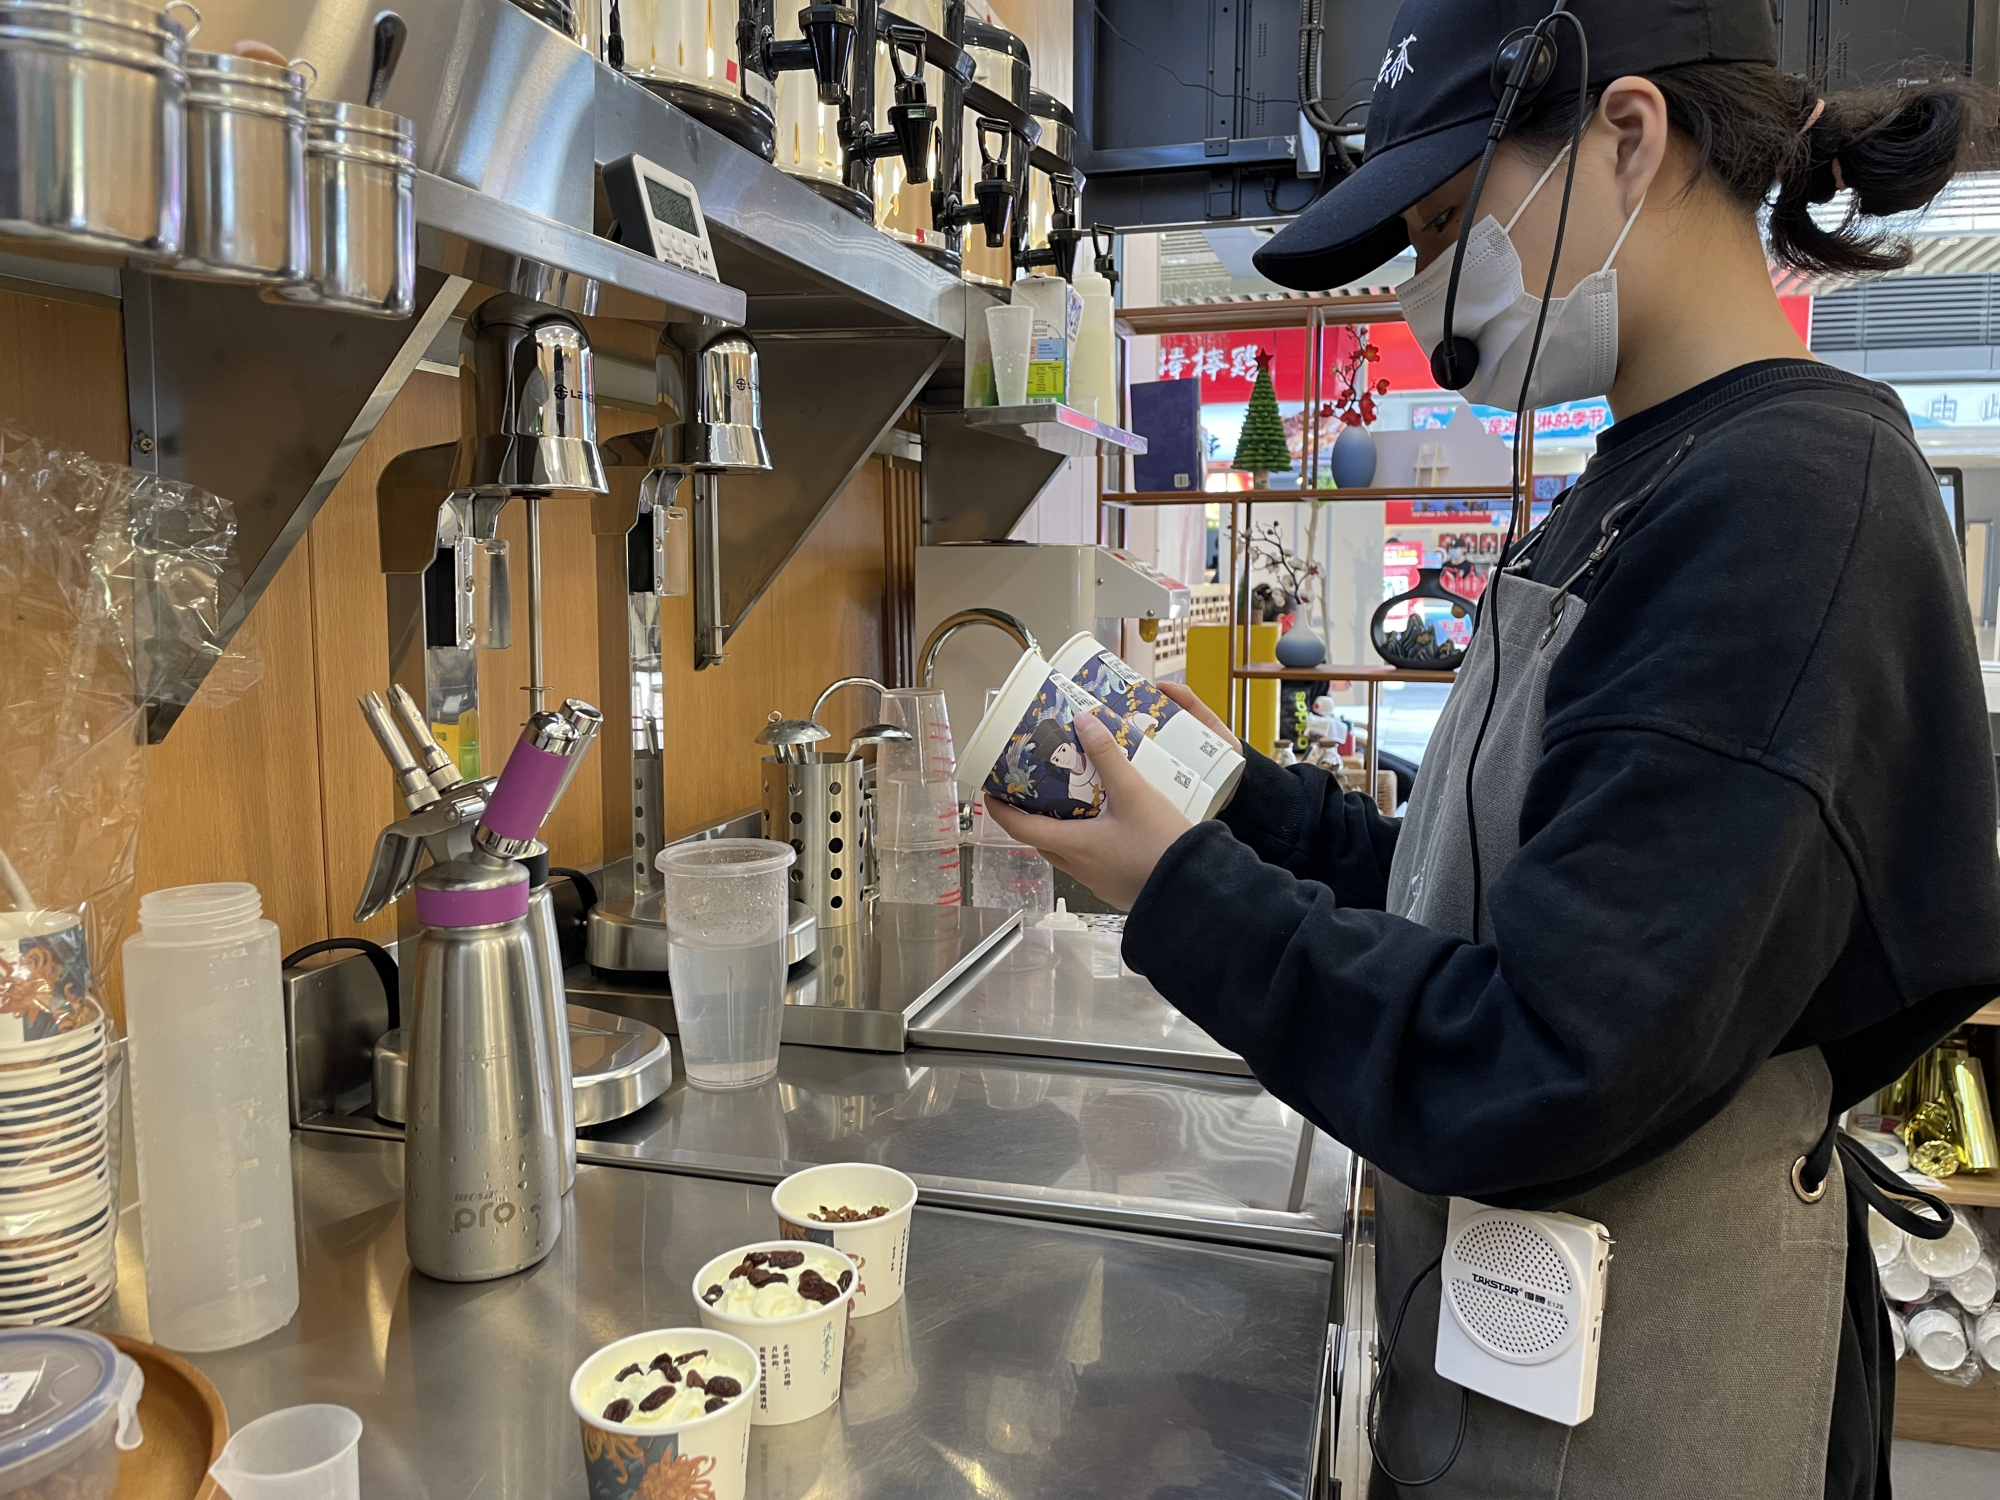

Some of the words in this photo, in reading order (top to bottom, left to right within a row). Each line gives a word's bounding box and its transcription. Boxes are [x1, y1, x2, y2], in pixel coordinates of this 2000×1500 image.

[1294, 690, 1309, 750] adidas
[454, 1202, 516, 1234] pro
[1471, 1272, 1519, 1297] TAKSTAR
[1547, 1300, 1564, 1310] E129
